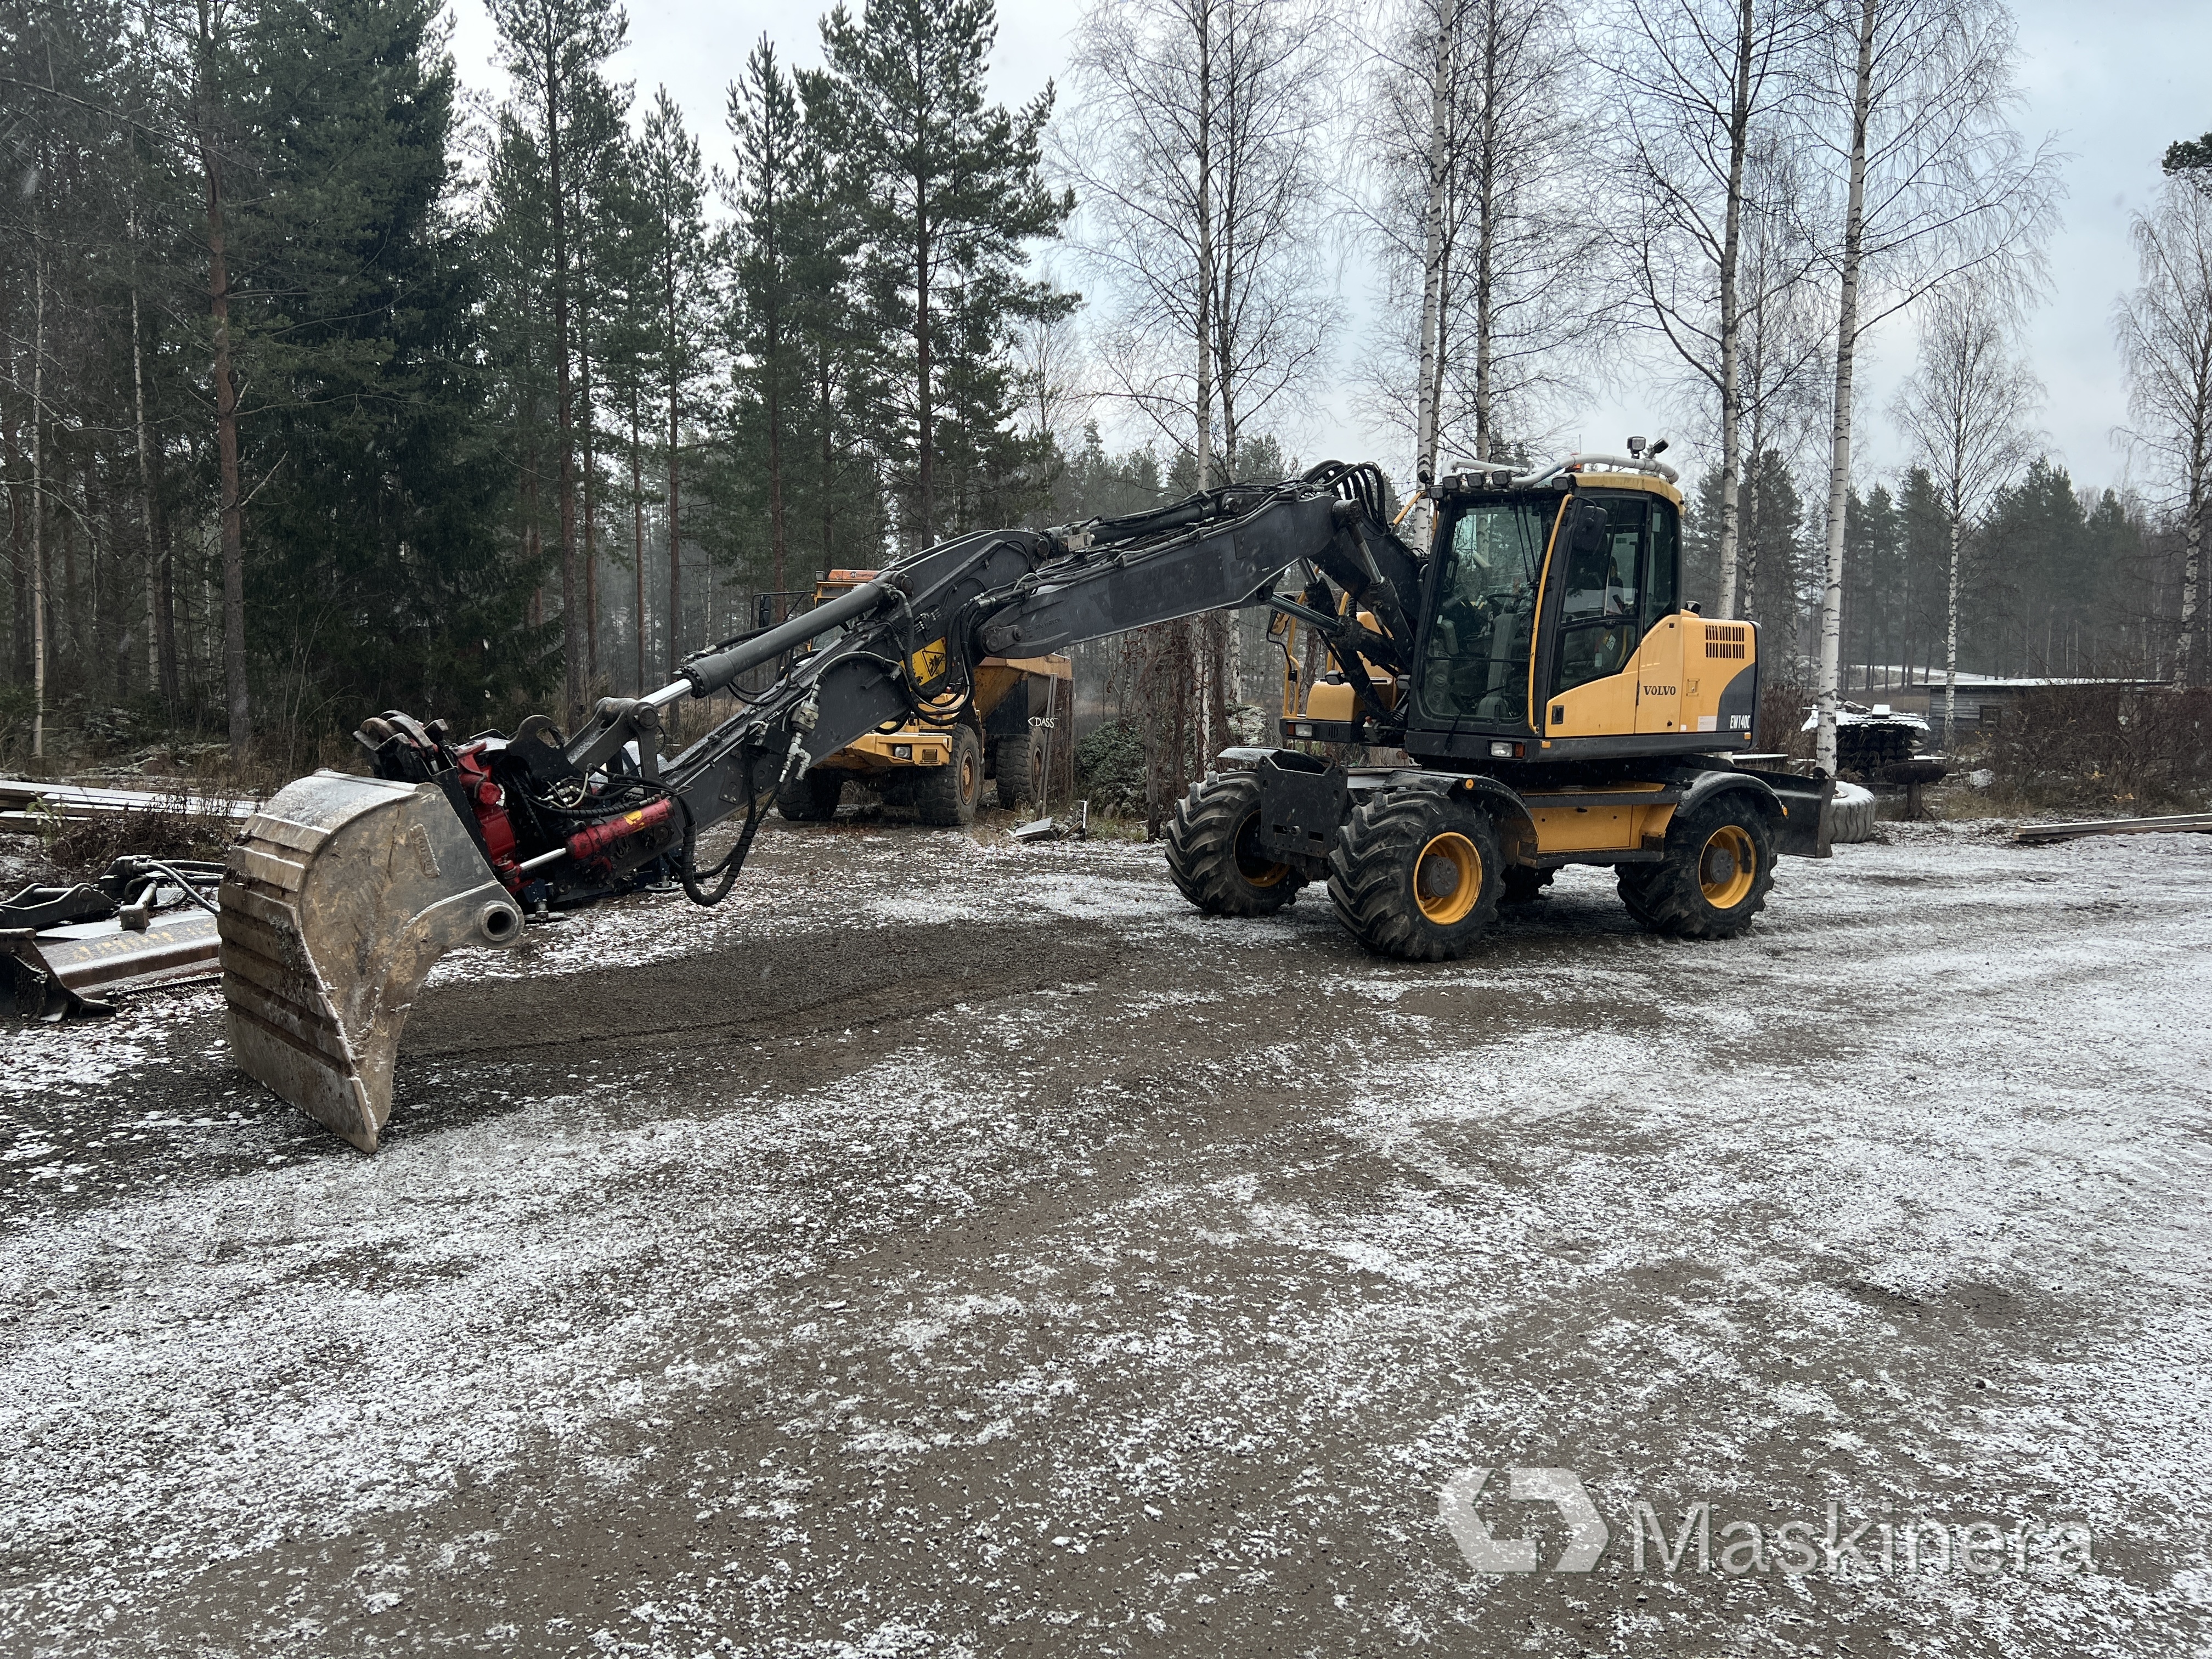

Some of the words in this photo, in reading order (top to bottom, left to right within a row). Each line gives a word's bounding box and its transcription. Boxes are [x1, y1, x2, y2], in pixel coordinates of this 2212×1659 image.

[1643, 686, 1676, 696] VOLVO
[1035, 717, 1054, 729] DASS
[1730, 715, 1751, 729] EW140C
